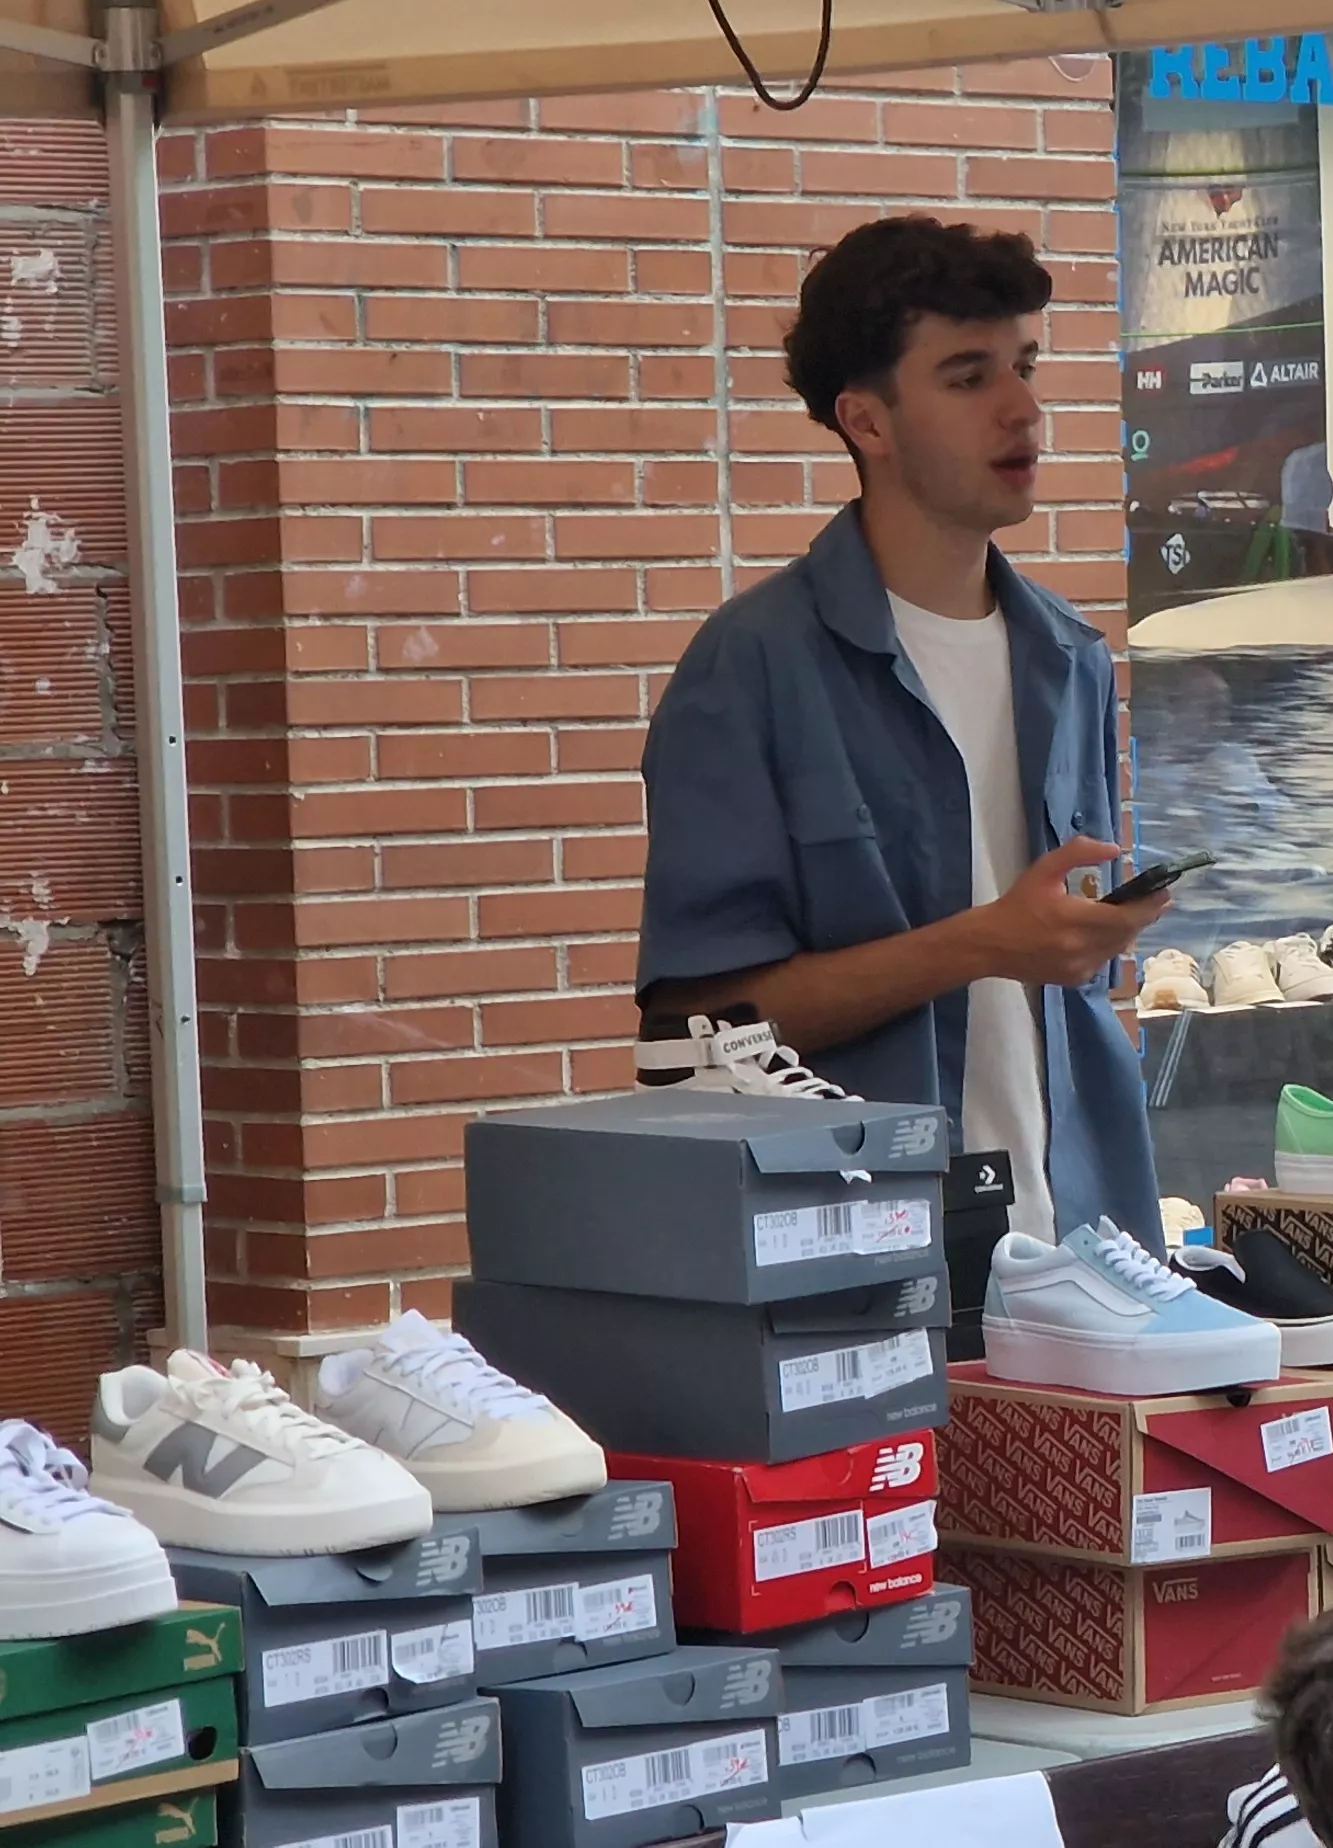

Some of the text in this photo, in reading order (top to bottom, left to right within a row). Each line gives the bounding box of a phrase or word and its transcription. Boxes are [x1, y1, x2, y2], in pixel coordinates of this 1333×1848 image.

[1158, 234, 1279, 266] AMERICAN
[1184, 267, 1261, 298] MAGIC
[1201, 371, 1244, 390] Parker
[1270, 362, 1319, 383] ALTAIR
[723, 1029, 773, 1054] CONVERSE
[1281, 1210, 1313, 1249] VANS
[968, 1400, 1005, 1445] VANS
[1064, 1417, 1103, 1465] VANS
[979, 1441, 1016, 1488] VANS
[1007, 1434, 1045, 1481] VANS
[1035, 1425, 1074, 1473] VANS
[1019, 1476, 1058, 1524] VANS
[1048, 1468, 1087, 1516] VANS
[1076, 1460, 1117, 1508] VANS
[869, 1573, 923, 1594] new balance
[1037, 1577, 1076, 1624] VANS
[1067, 1569, 1105, 1617] VANS
[1152, 1577, 1198, 1603] VANS
[1008, 1585, 1047, 1632] VANS
[992, 1635, 1030, 1681] VANS
[1020, 1627, 1059, 1673] VANS
[1049, 1619, 1088, 1667] VANS
[1078, 1612, 1118, 1659] VANS
